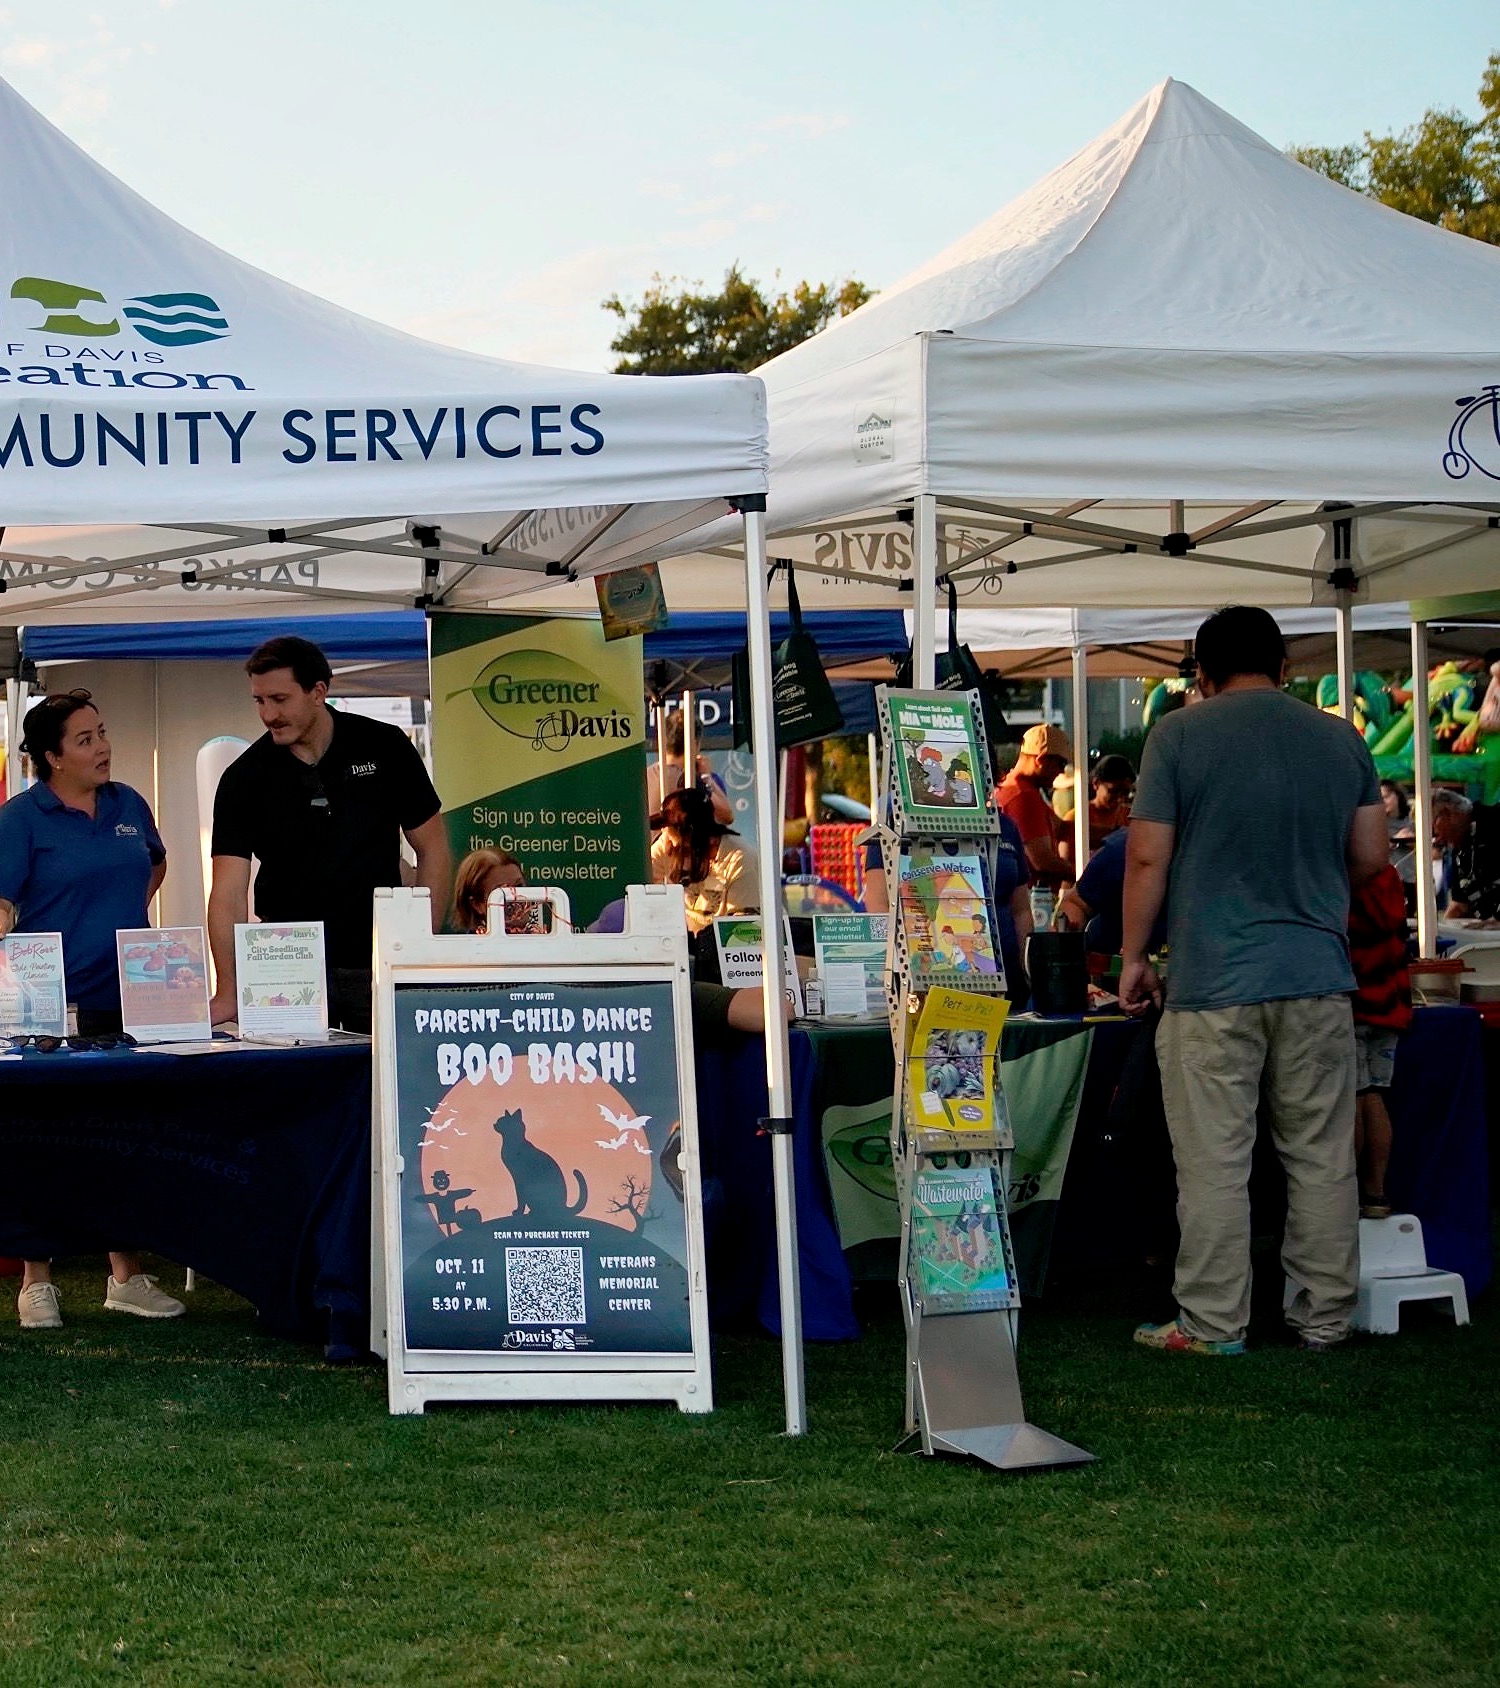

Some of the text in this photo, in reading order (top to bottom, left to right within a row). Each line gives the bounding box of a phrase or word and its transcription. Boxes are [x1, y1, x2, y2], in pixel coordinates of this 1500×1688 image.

[45, 343, 165, 364] DAVIS
[282, 403, 605, 464] SERVICES
[489, 673, 600, 705] Greener
[560, 709, 632, 740] Davis
[931, 714, 965, 729] MOLE
[473, 807, 621, 828] Sign up to receive
[470, 834, 621, 852] the Greener Davis
[530, 863, 617, 880] newsletter
[901, 861, 977, 881] Conserve Water
[853, 916, 865, 924] for
[838, 924, 861, 932] email
[821, 933, 865, 941] newsletter!
[246, 951, 314, 961] Fall Garden Club
[251, 944, 309, 955] City Seedlings
[725, 952, 763, 963] Follow
[509, 992, 555, 1001] CITY OF DAVIS
[415, 1007, 652, 1034] PARENT-CHILD DANCE
[437, 1041, 637, 1086] BOO BASH!
[918, 1182, 987, 1205] Wastewater
[493, 1230, 590, 1240] SCAN TO PURCHASE TICKETS
[435, 1258, 485, 1275] OCT. 11
[599, 1255, 656, 1270] VETERANS
[455, 1281, 466, 1292] AT
[599, 1276, 660, 1290] MEMORIAL
[432, 1297, 492, 1311] 5:30 P.M.
[608, 1297, 652, 1312] CENTER
[515, 1329, 553, 1344] Davis
